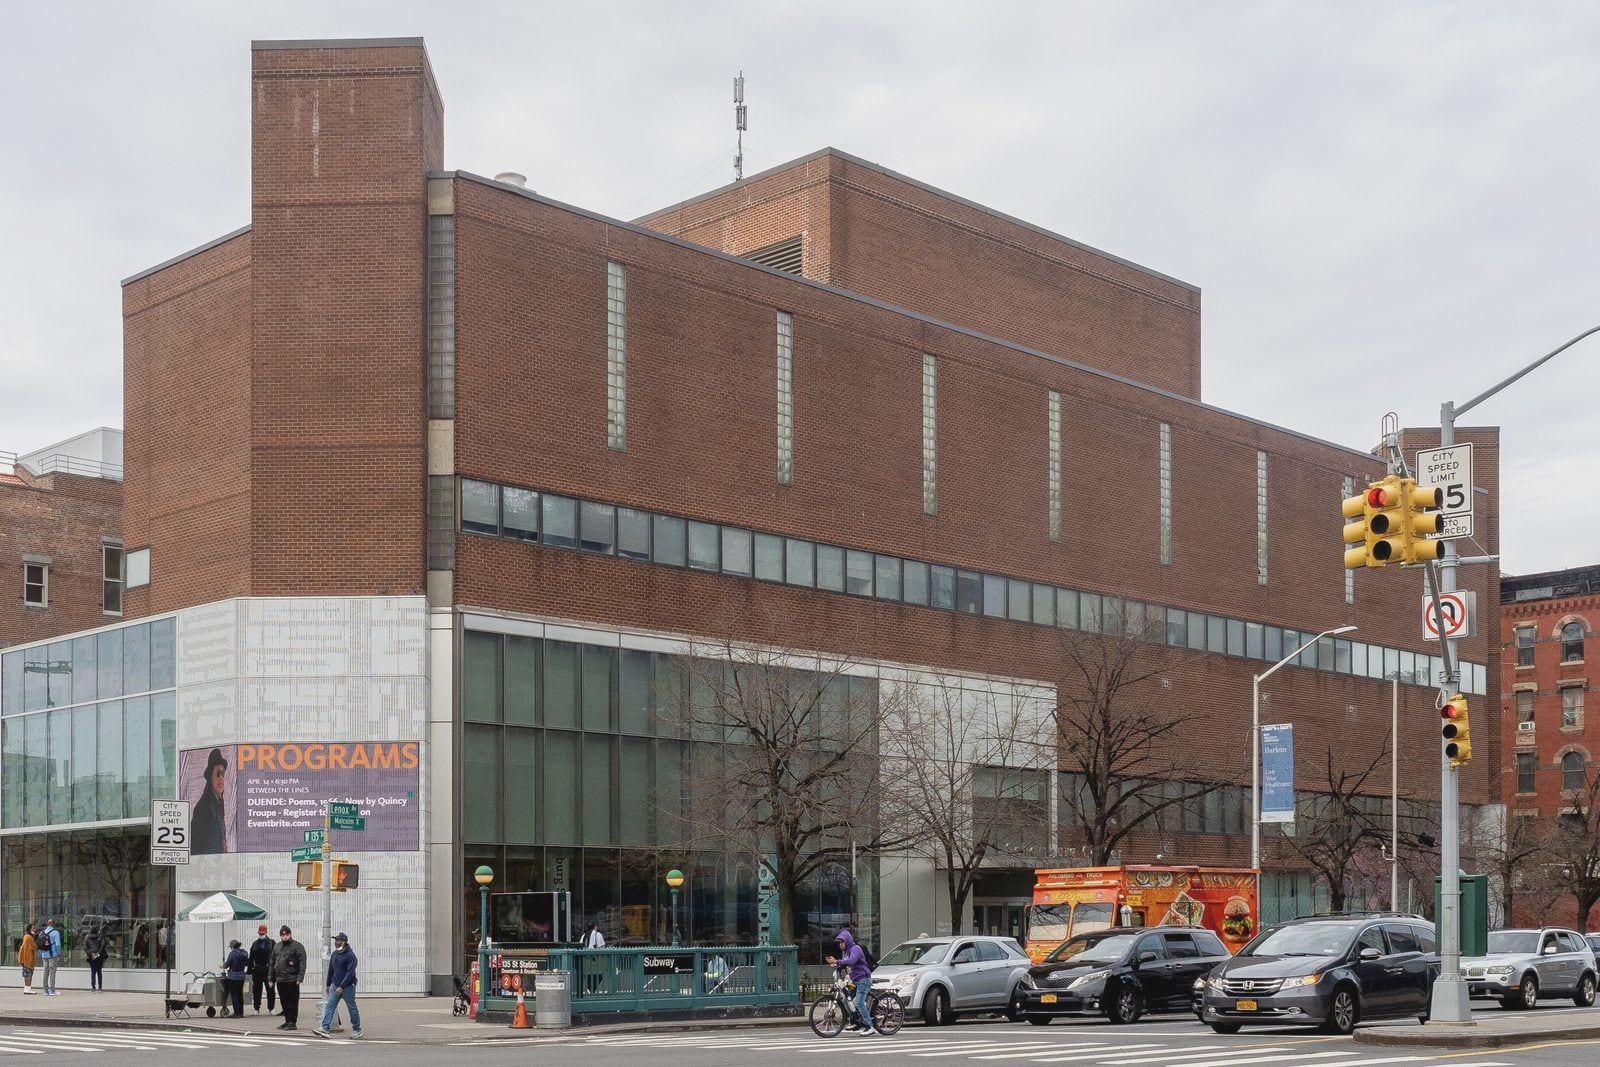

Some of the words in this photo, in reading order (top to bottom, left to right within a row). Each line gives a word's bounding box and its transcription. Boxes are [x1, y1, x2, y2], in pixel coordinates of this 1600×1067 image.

[1432, 451, 1454, 462] CITY
[1428, 462, 1459, 473] SPEED
[1431, 473, 1456, 483] LIMIT
[1446, 483, 1465, 509] 5
[1264, 746, 1287, 754] Harlem
[237, 743, 418, 770] PROGRAMS
[247, 798, 287, 806] DUENDE:
[288, 797, 318, 807] Poems,
[345, 796, 364, 805] Now
[365, 797, 377, 807] by
[377, 797, 408, 807] Quincy
[247, 808, 277, 818] Troupe
[283, 808, 317, 819] Register
[331, 804, 350, 815] Lenox
[247, 820, 310, 828] Eventbrite.com
[334, 817, 354, 825] Malcolm
[157, 826, 185, 844] 25
[305, 832, 310, 842] W
[520, 960, 538, 969] Station
[644, 956, 675, 968] Subway
[504, 977, 509, 986] 2
[514, 978, 519, 986] 3
